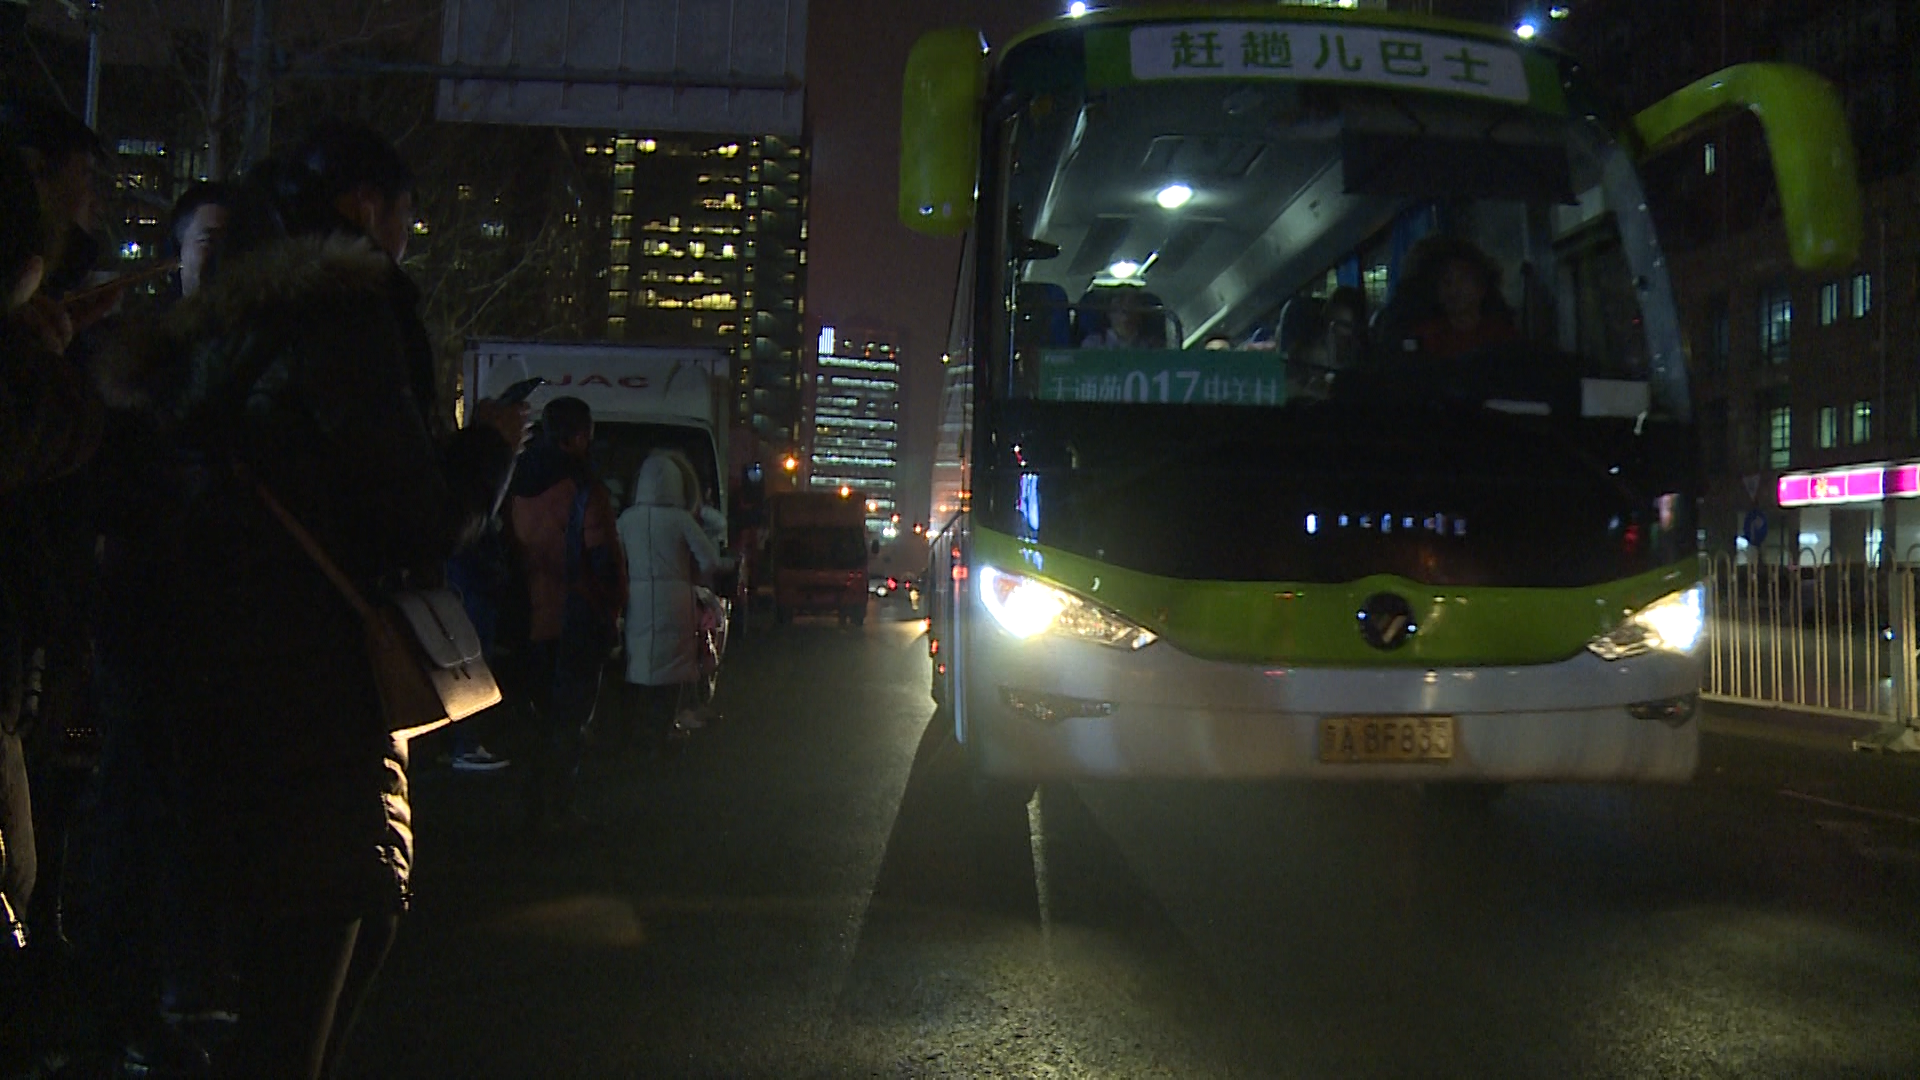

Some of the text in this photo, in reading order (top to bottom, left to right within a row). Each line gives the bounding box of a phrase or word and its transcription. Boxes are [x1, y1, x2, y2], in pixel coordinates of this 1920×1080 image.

[1171, 30, 1490, 86] 赶趟儿巴士
[549, 373, 649, 388] JAC
[1123, 370, 1200, 403] 017
